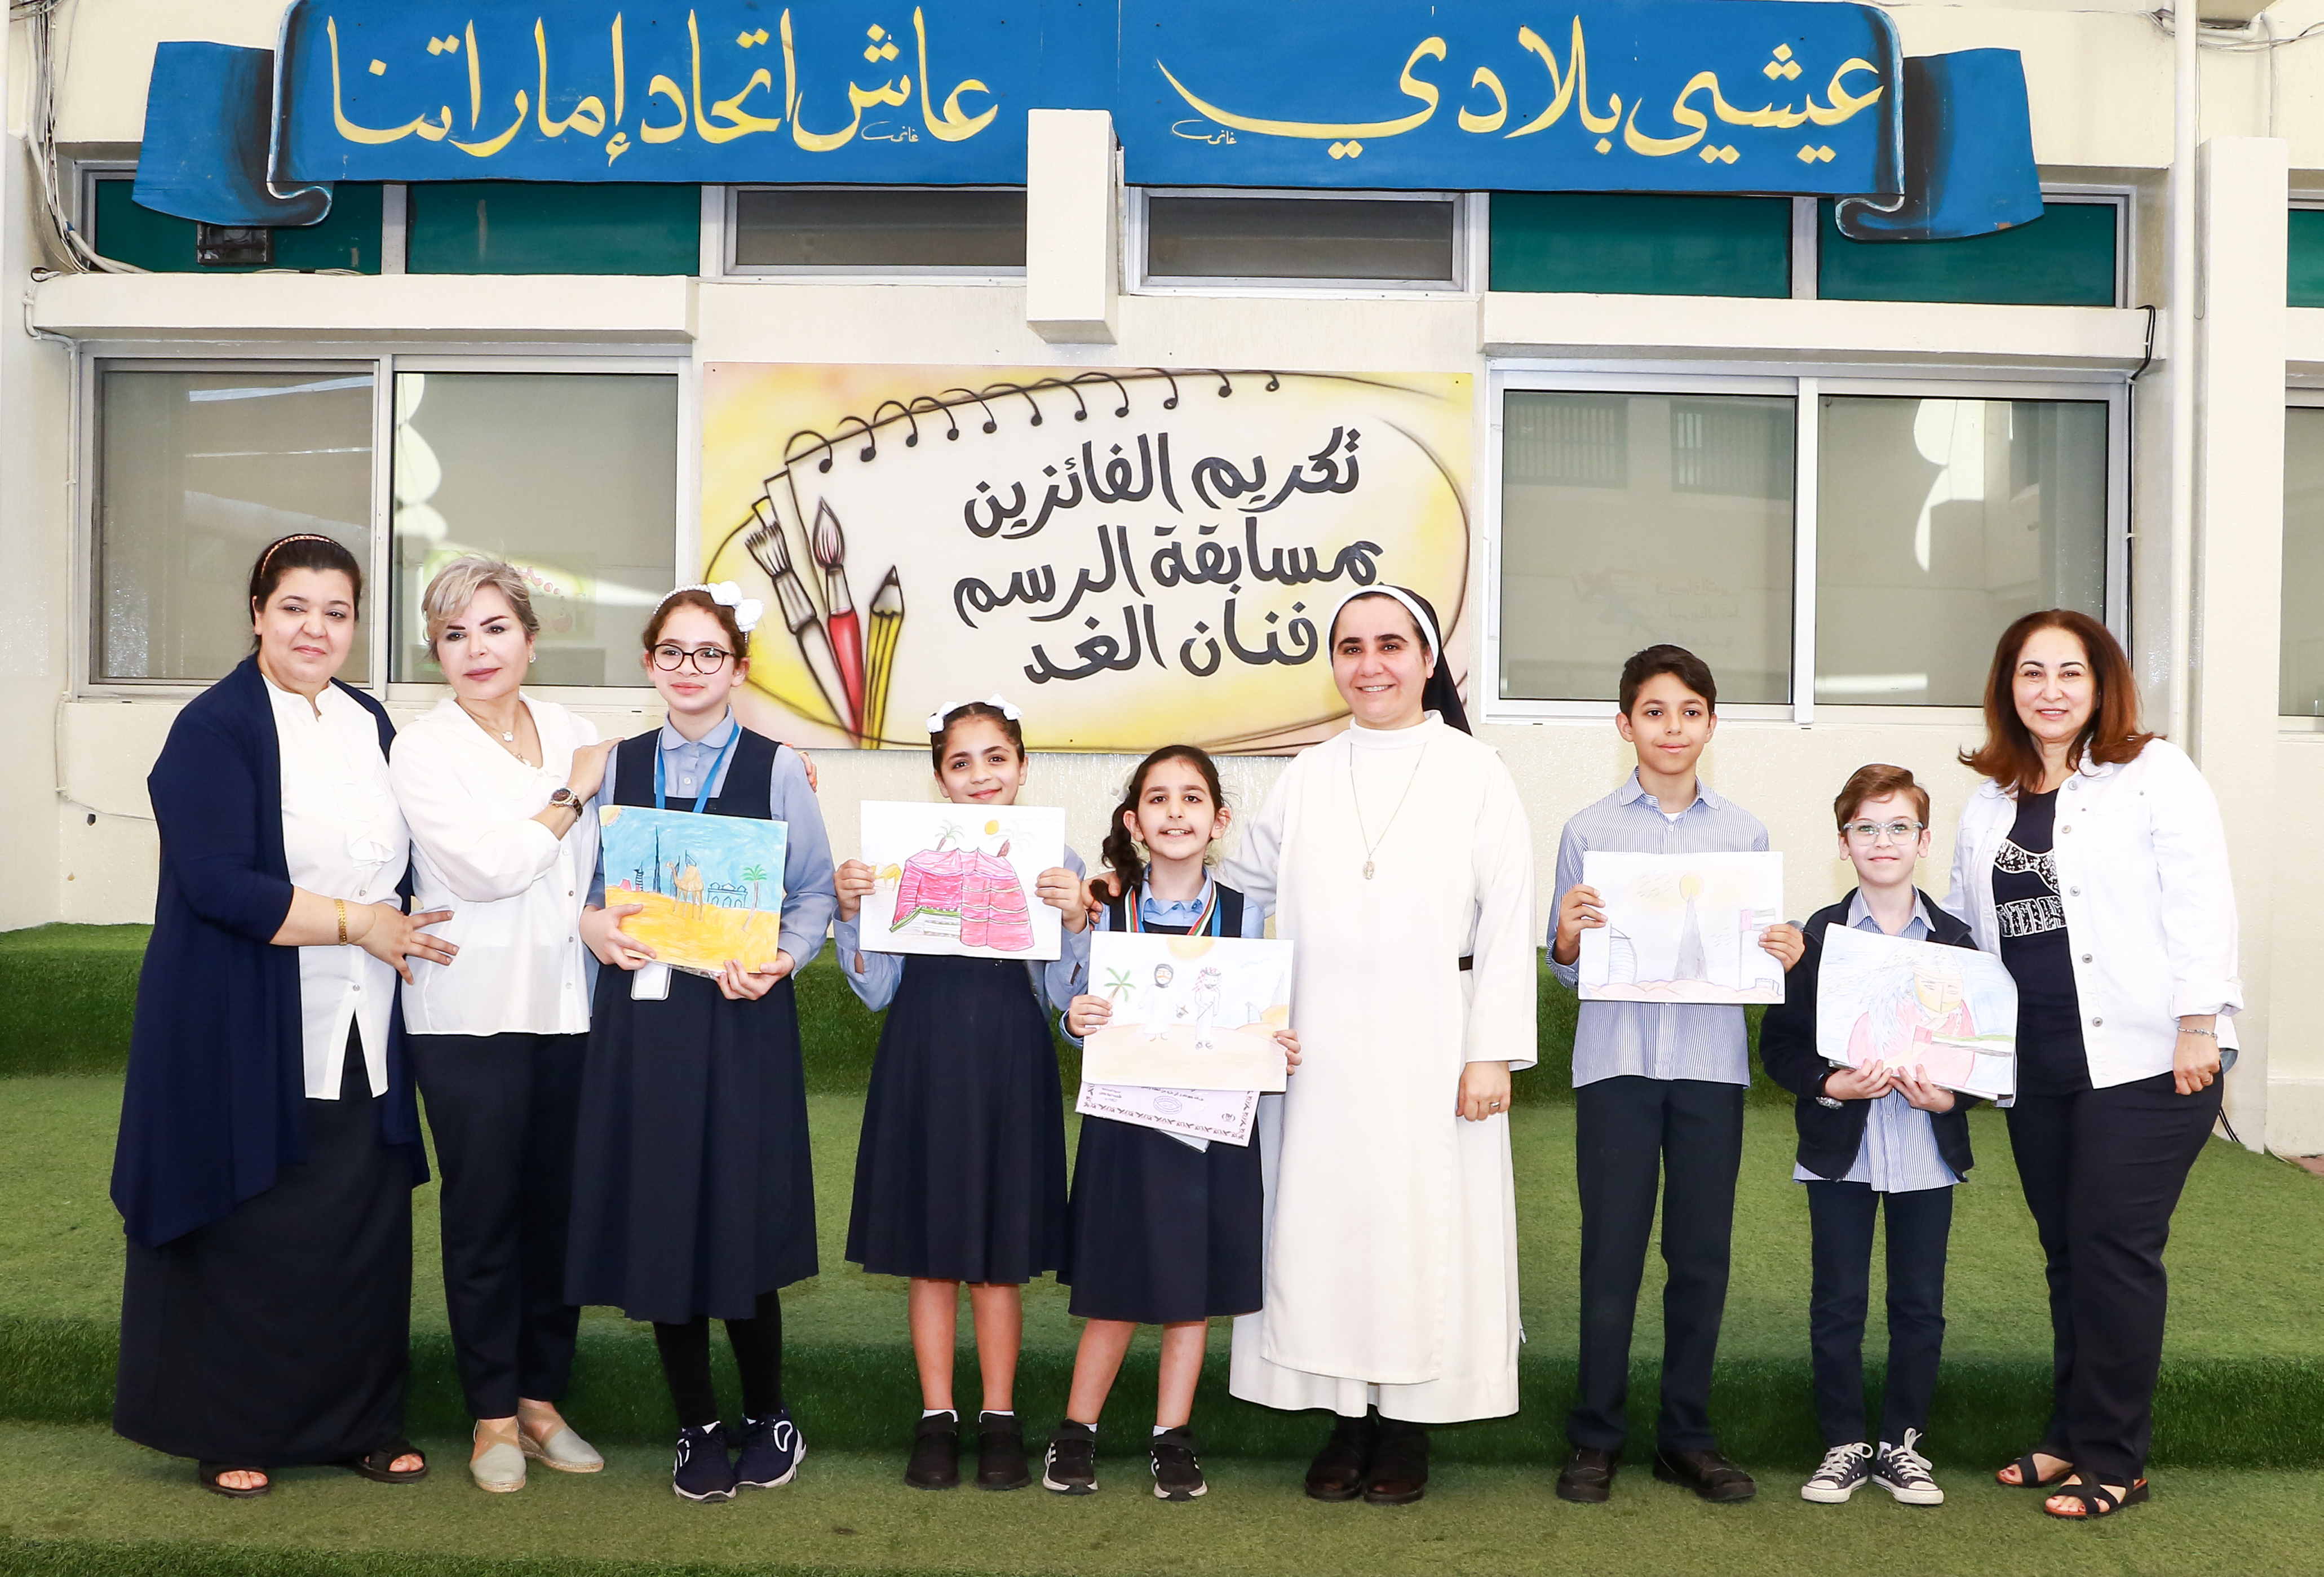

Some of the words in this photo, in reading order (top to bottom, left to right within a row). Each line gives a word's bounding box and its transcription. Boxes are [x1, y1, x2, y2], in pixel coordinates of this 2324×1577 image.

[326, 11, 632, 167] إماراتنا
[640, 8, 796, 144] اتحاد
[793, 6, 998, 152] عاش
[1157, 15, 1622, 161] بلادي
[1623, 42, 1884, 165] عيشي
[963, 432, 1184, 540] الفائزين
[1190, 426, 1361, 513] تكريم
[953, 524, 1146, 630] الرسم
[1023, 603, 1168, 685] الغد
[1179, 597, 1319, 677] فنان
